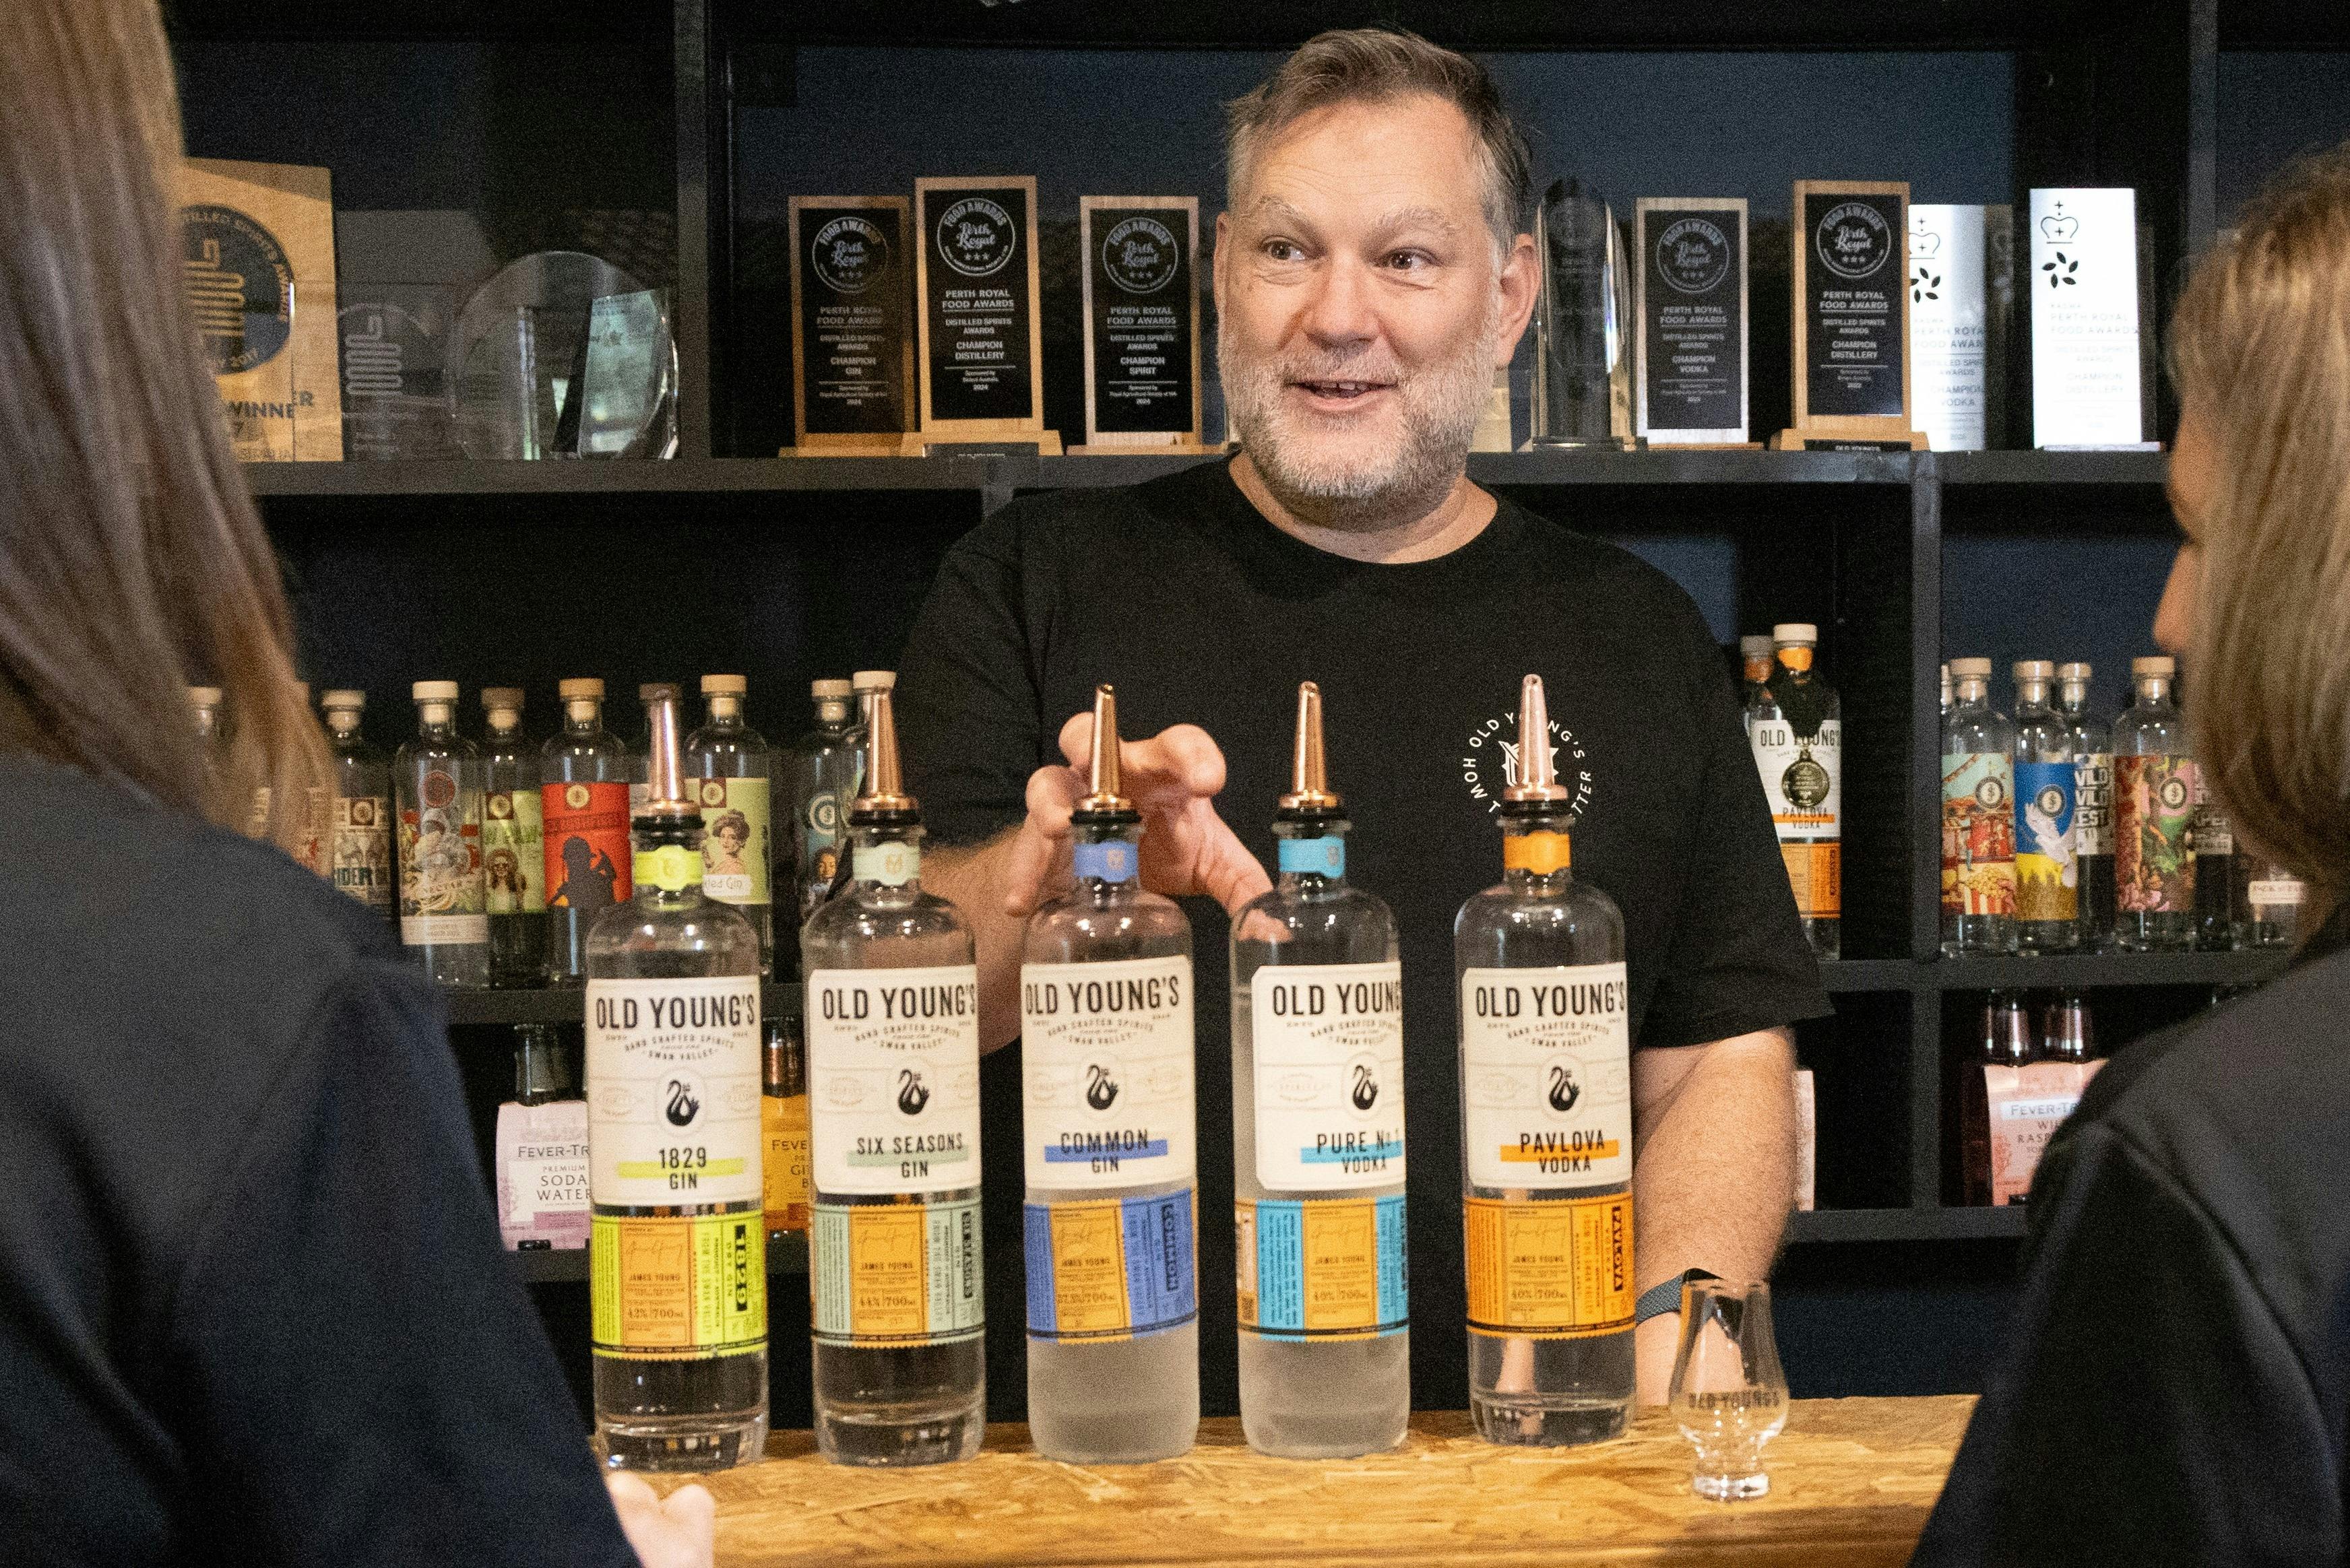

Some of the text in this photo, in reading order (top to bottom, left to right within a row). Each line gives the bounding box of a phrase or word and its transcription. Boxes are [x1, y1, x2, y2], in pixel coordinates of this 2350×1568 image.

[943, 201, 1008, 228] FOOD AWARDS
[958, 222, 991, 236] Perth
[956, 232, 996, 250] Royal
[945, 289, 1011, 298] PERTH ROYAL
[1822, 291, 1852, 299] PERTH
[942, 300, 1014, 309] FOOD AWARDS
[1110, 306, 1172, 315] PERTH ROYAL
[1820, 301, 1847, 309] FOOD
[945, 318, 983, 326] DISTILLED
[1660, 315, 1727, 324] FOOD AWARDS
[2050, 313, 2128, 321] PERTH ROYAL
[1914, 326, 1983, 335] PERTH ROYA
[2050, 325, 2138, 334] FOOD AWARDS
[956, 341, 1003, 350] CHAMPION
[1832, 341, 1877, 350] CHAMPION
[1914, 339, 1983, 348] FOOD AWAR
[955, 352, 1005, 360] DISTILLERY
[1120, 357, 1166, 365] CHAMPION
[1672, 356, 1716, 364] CHAMPION
[1831, 351, 1878, 359] DISTILLERY
[1129, 367, 1157, 375] SPIRIT
[1679, 365, 1709, 374] VODKA
[1469, 712, 1585, 759] OLD YNG'S
[1760, 729, 1785, 746] OLD
[1570, 771, 1591, 814] TTER
[1782, 807, 1828, 818] PAVLOVA
[1793, 820, 1820, 829] VODKA
[1025, 975, 1179, 1015] OLD YOUNG'S
[1273, 985, 1324, 1016] OLD
[1475, 981, 1625, 1018] OLD YOUNG'S
[823, 983, 976, 1020] OLD YOUNG'S
[596, 994, 755, 1029] OLD YOUNG'S
[856, 1132, 962, 1155] SIX SEASONS
[1060, 1129, 1148, 1154] COMMON
[1317, 1132, 1367, 1154] PURE
[1520, 1130, 1605, 1153] PAVLOVA
[517, 1145, 590, 1158] FEVER-TR
[658, 1147, 707, 1169] 1829
[1539, 1155, 1591, 1173] VODKA
[901, 1161, 928, 1179] GIN
[1091, 1157, 1119, 1173] GIN
[1341, 1156, 1387, 1173] VODKA
[540, 1174, 587, 1186] SODA
[669, 1173, 698, 1190] GIN
[536, 1189, 592, 1200] WATER
[1614, 1210, 1623, 1287] PAVLOVA
[736, 1234, 746, 1304] 1829
[630, 1272, 680, 1281] JAMES YOUNG
[627, 1309, 647, 1319] 42%
